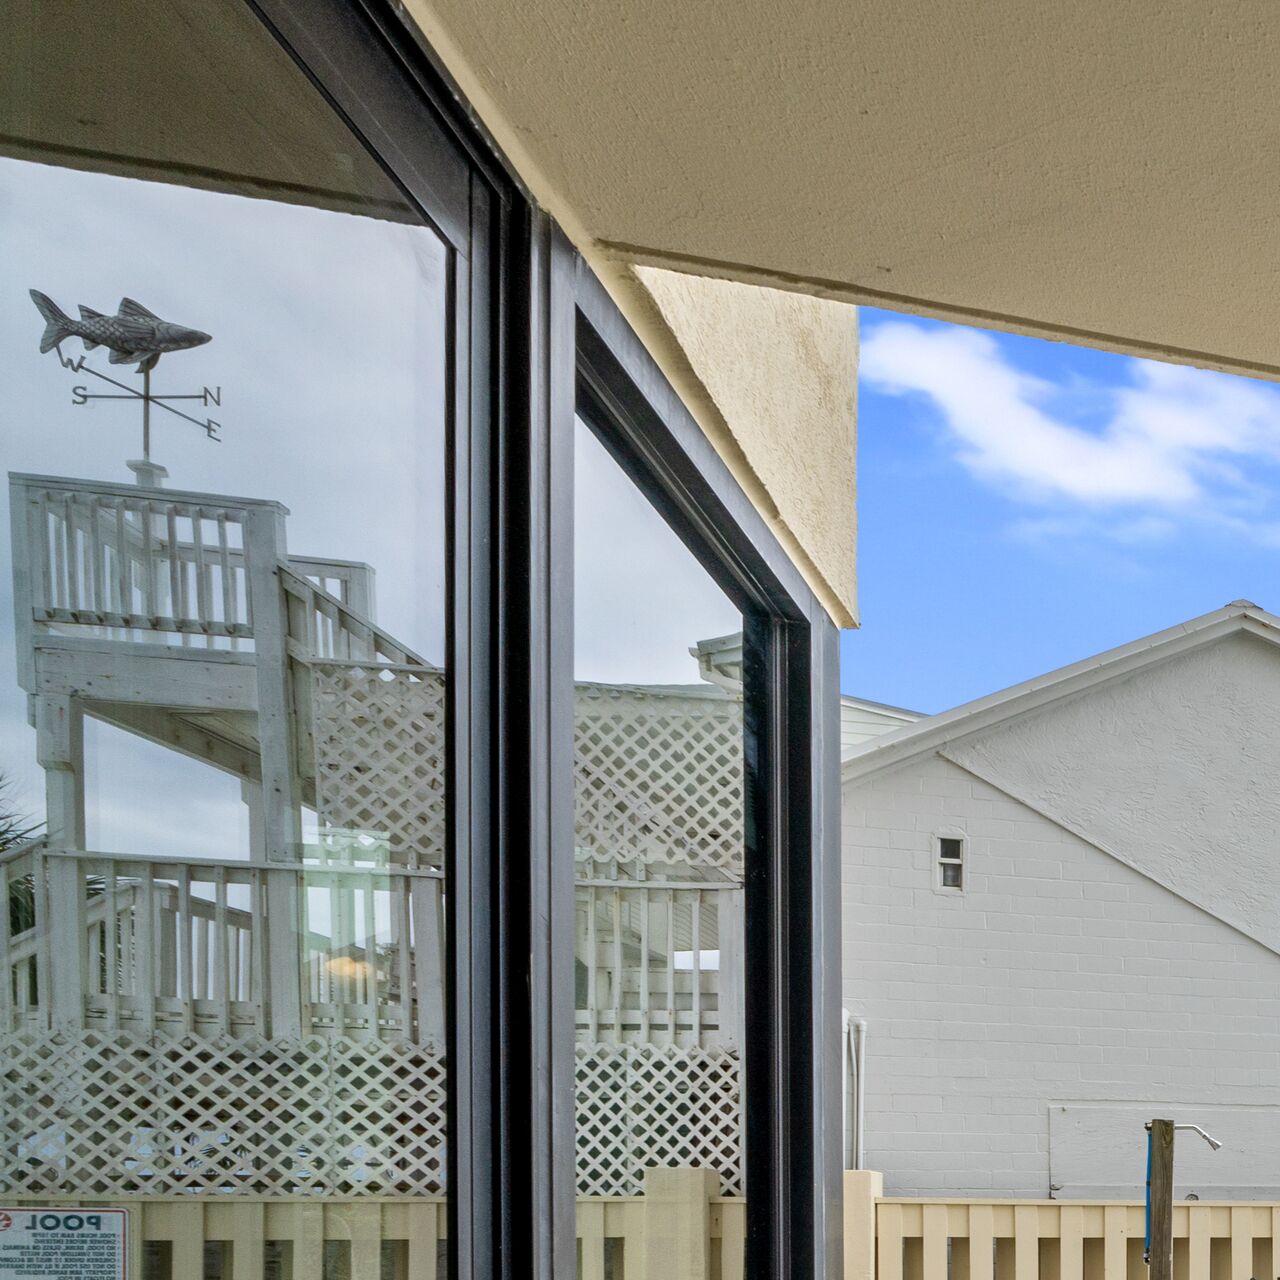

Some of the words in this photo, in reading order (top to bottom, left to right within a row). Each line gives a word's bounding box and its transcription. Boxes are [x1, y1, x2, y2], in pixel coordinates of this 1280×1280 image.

[72, 386, 87, 405] S
[203, 386, 221, 406] N
[207, 418, 221, 442] E
